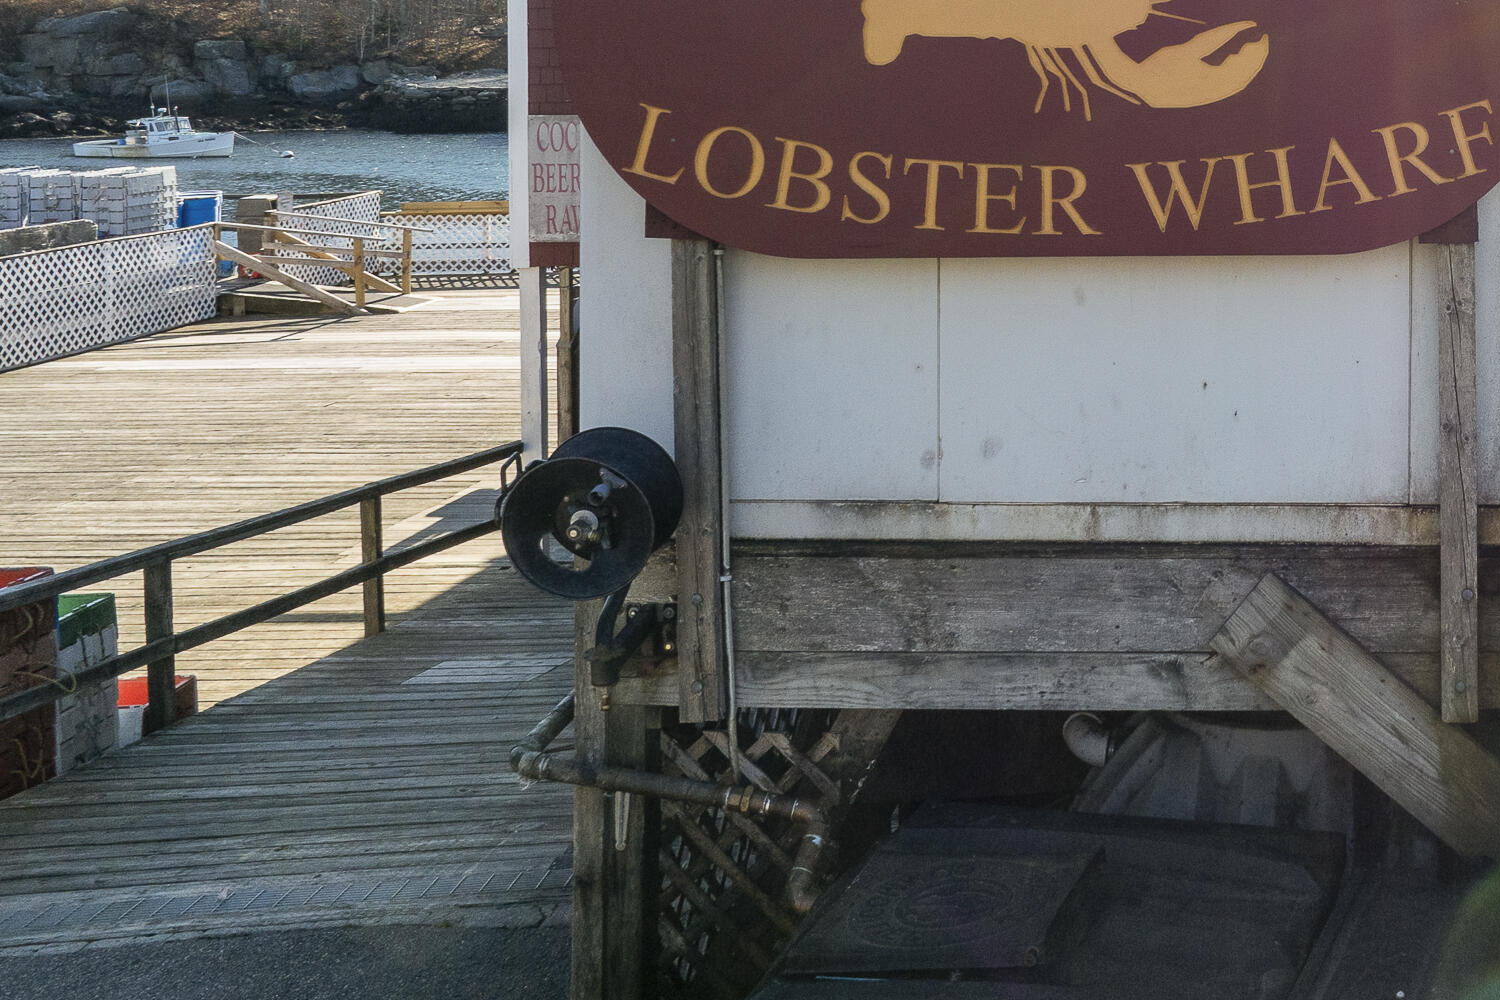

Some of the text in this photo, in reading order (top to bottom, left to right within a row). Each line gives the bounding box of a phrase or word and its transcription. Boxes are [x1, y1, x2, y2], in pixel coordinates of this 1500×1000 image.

[532, 163, 580, 193] BEER
[622, 99, 1495, 236] LOBSTER WHARF
